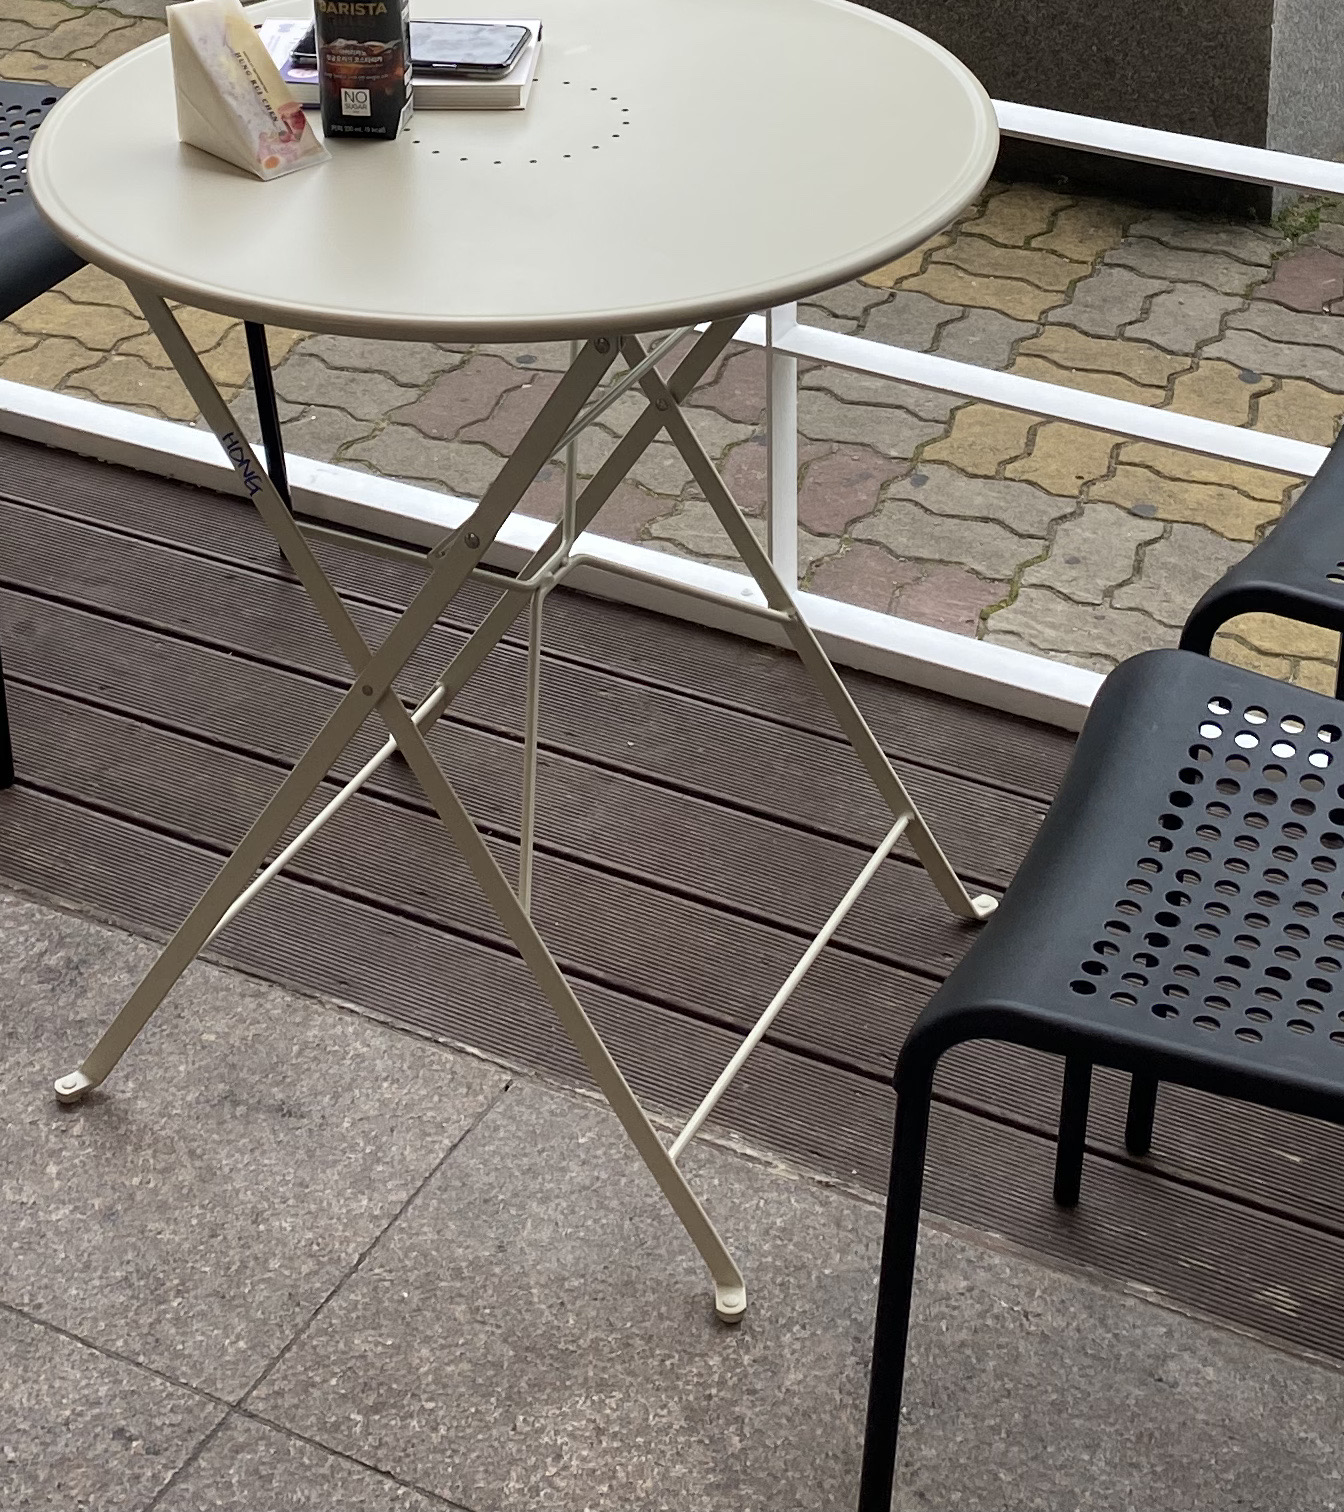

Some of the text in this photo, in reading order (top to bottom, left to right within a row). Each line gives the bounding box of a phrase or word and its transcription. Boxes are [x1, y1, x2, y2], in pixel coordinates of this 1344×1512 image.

[317, 1, 388, 17] BARISTA
[344, 91, 369, 104] NO
[344, 103, 369, 111] SUGAR
